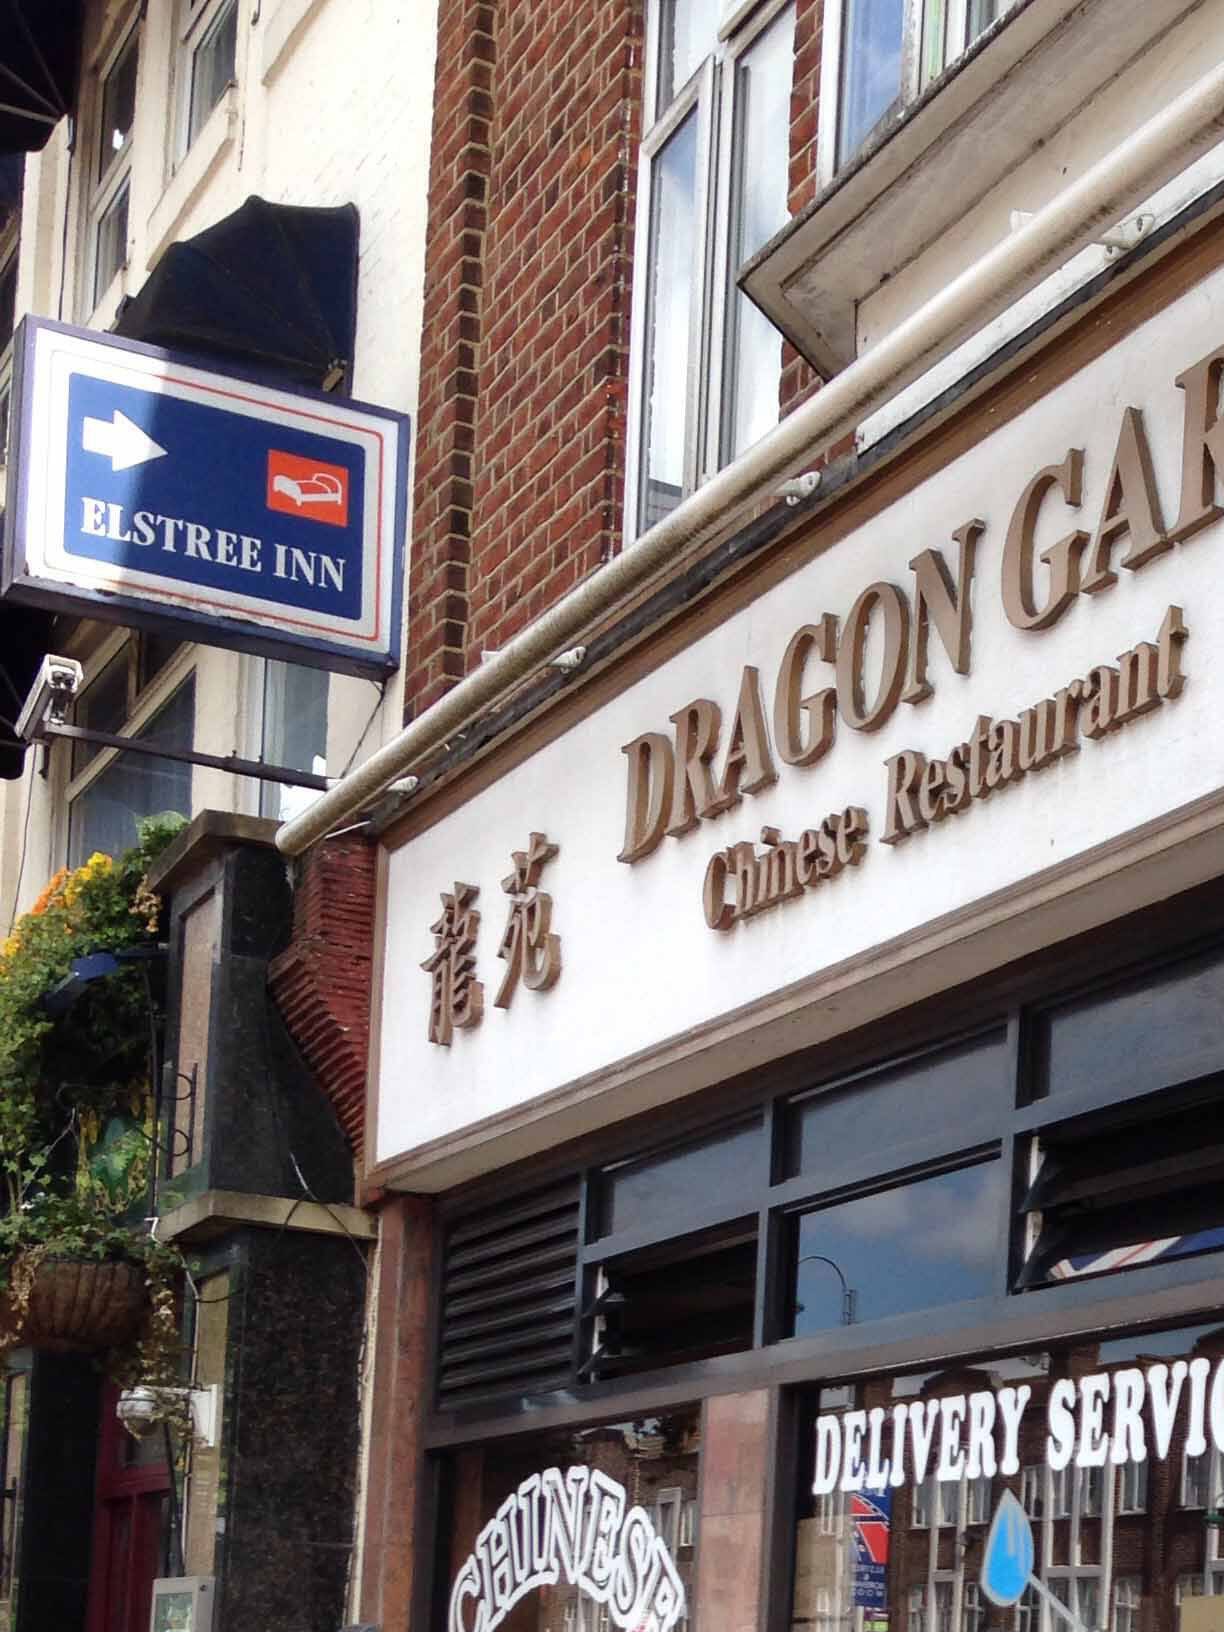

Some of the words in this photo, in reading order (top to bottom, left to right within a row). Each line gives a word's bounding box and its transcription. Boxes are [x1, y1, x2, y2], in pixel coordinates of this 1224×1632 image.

[81, 497, 261, 572] ELSTREE
[273, 544, 346, 592] INN
[617, 518, 984, 864] DRAGON
[703, 804, 868, 931] Chinese
[879, 606, 1190, 846] Restaurant
[419, 831, 561, 1047] 龍苑
[812, 1384, 1031, 1495] DELIVERY
